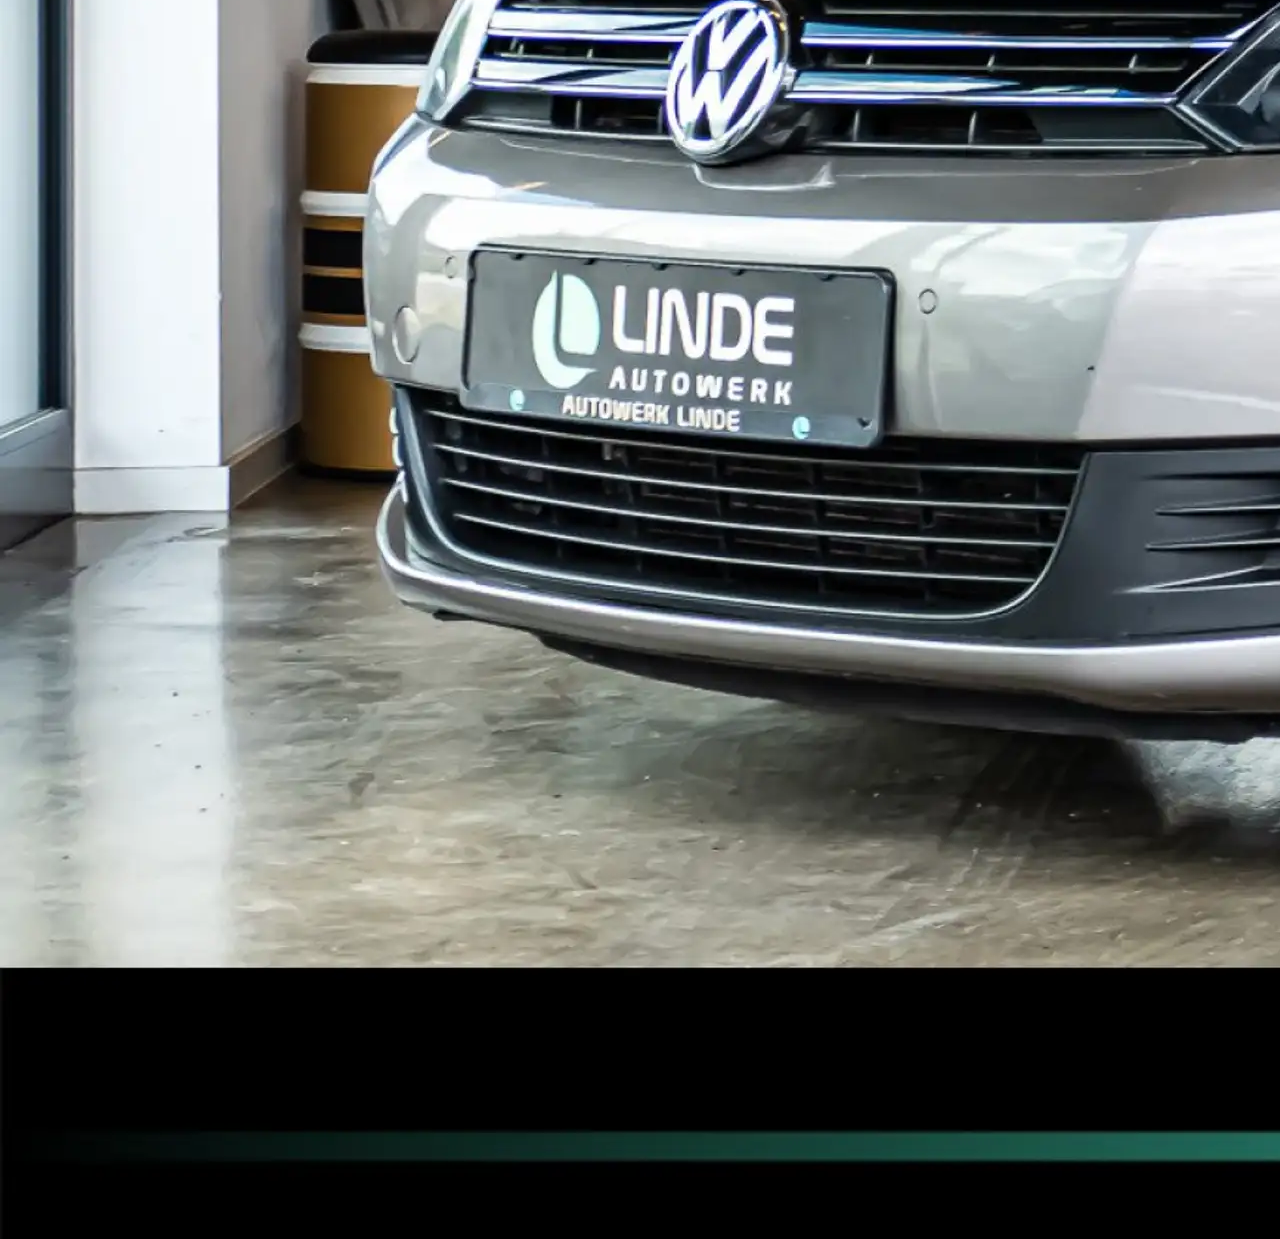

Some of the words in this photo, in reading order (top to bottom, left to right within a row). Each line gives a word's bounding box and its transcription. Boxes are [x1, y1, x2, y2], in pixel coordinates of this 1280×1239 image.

[667, 0, 782, 153] VW
[612, 284, 795, 366] LINDE
[562, 395, 669, 426] AUTOWERK
[676, 406, 740, 432] LINDE
[608, 366, 793, 405] AUTOWERK
